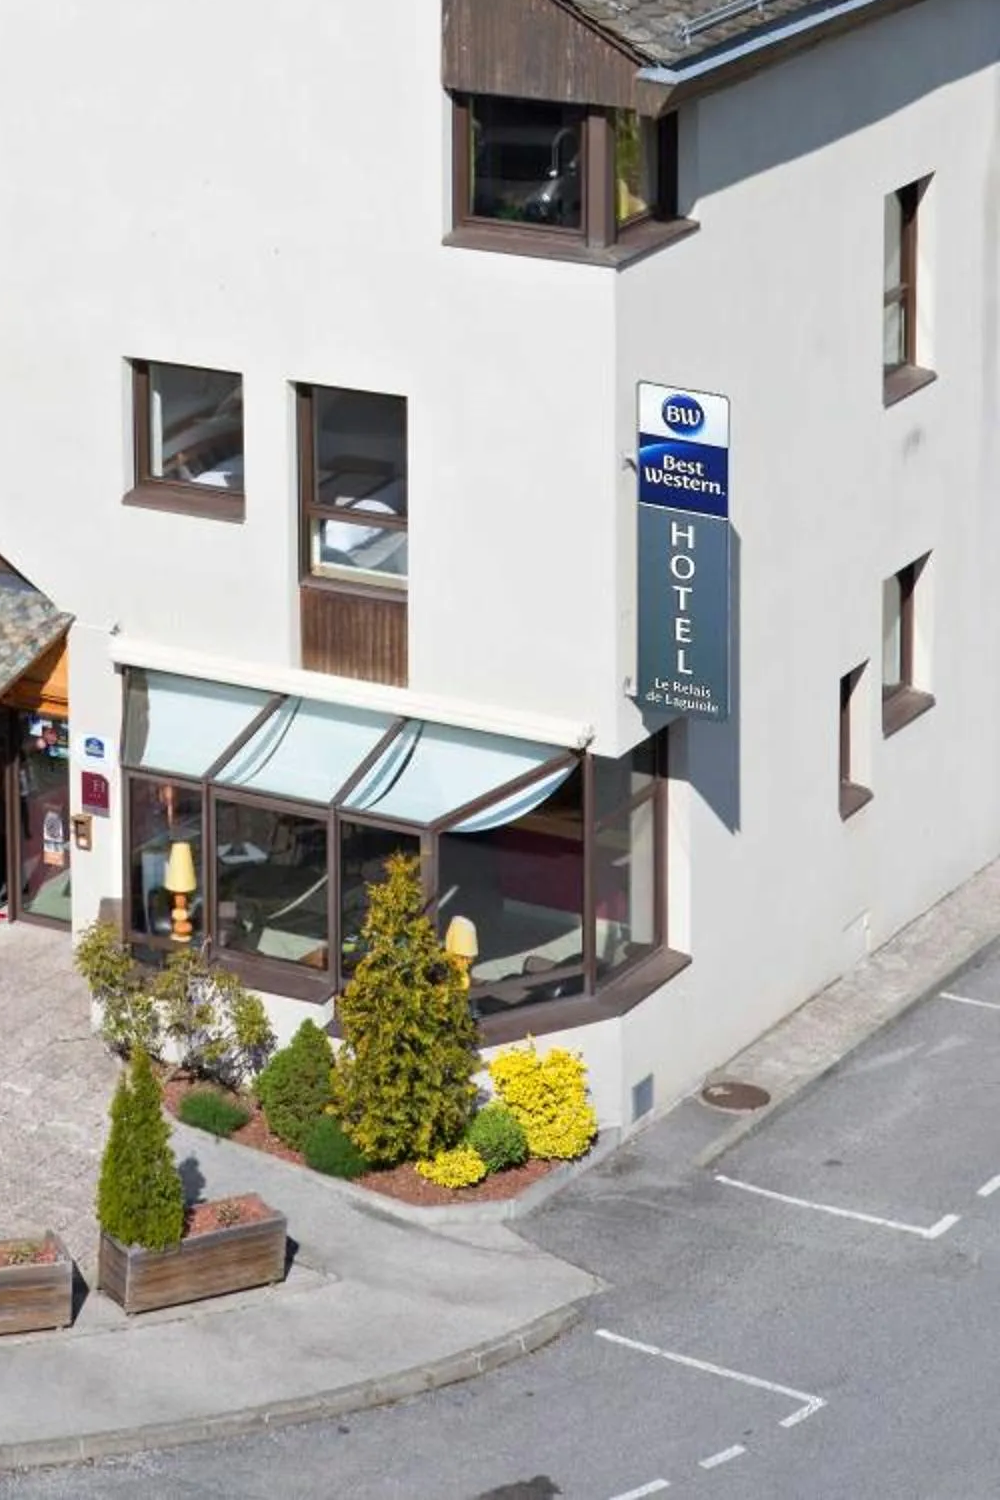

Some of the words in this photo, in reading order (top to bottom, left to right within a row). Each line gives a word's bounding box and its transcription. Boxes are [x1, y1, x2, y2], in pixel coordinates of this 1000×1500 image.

[666, 405, 701, 426] BW
[663, 454, 704, 477] Best
[670, 521, 695, 675] HOTEL
[645, 690, 663, 703] de
[655, 678, 669, 691] Le
[673, 681, 711, 698] Relais
